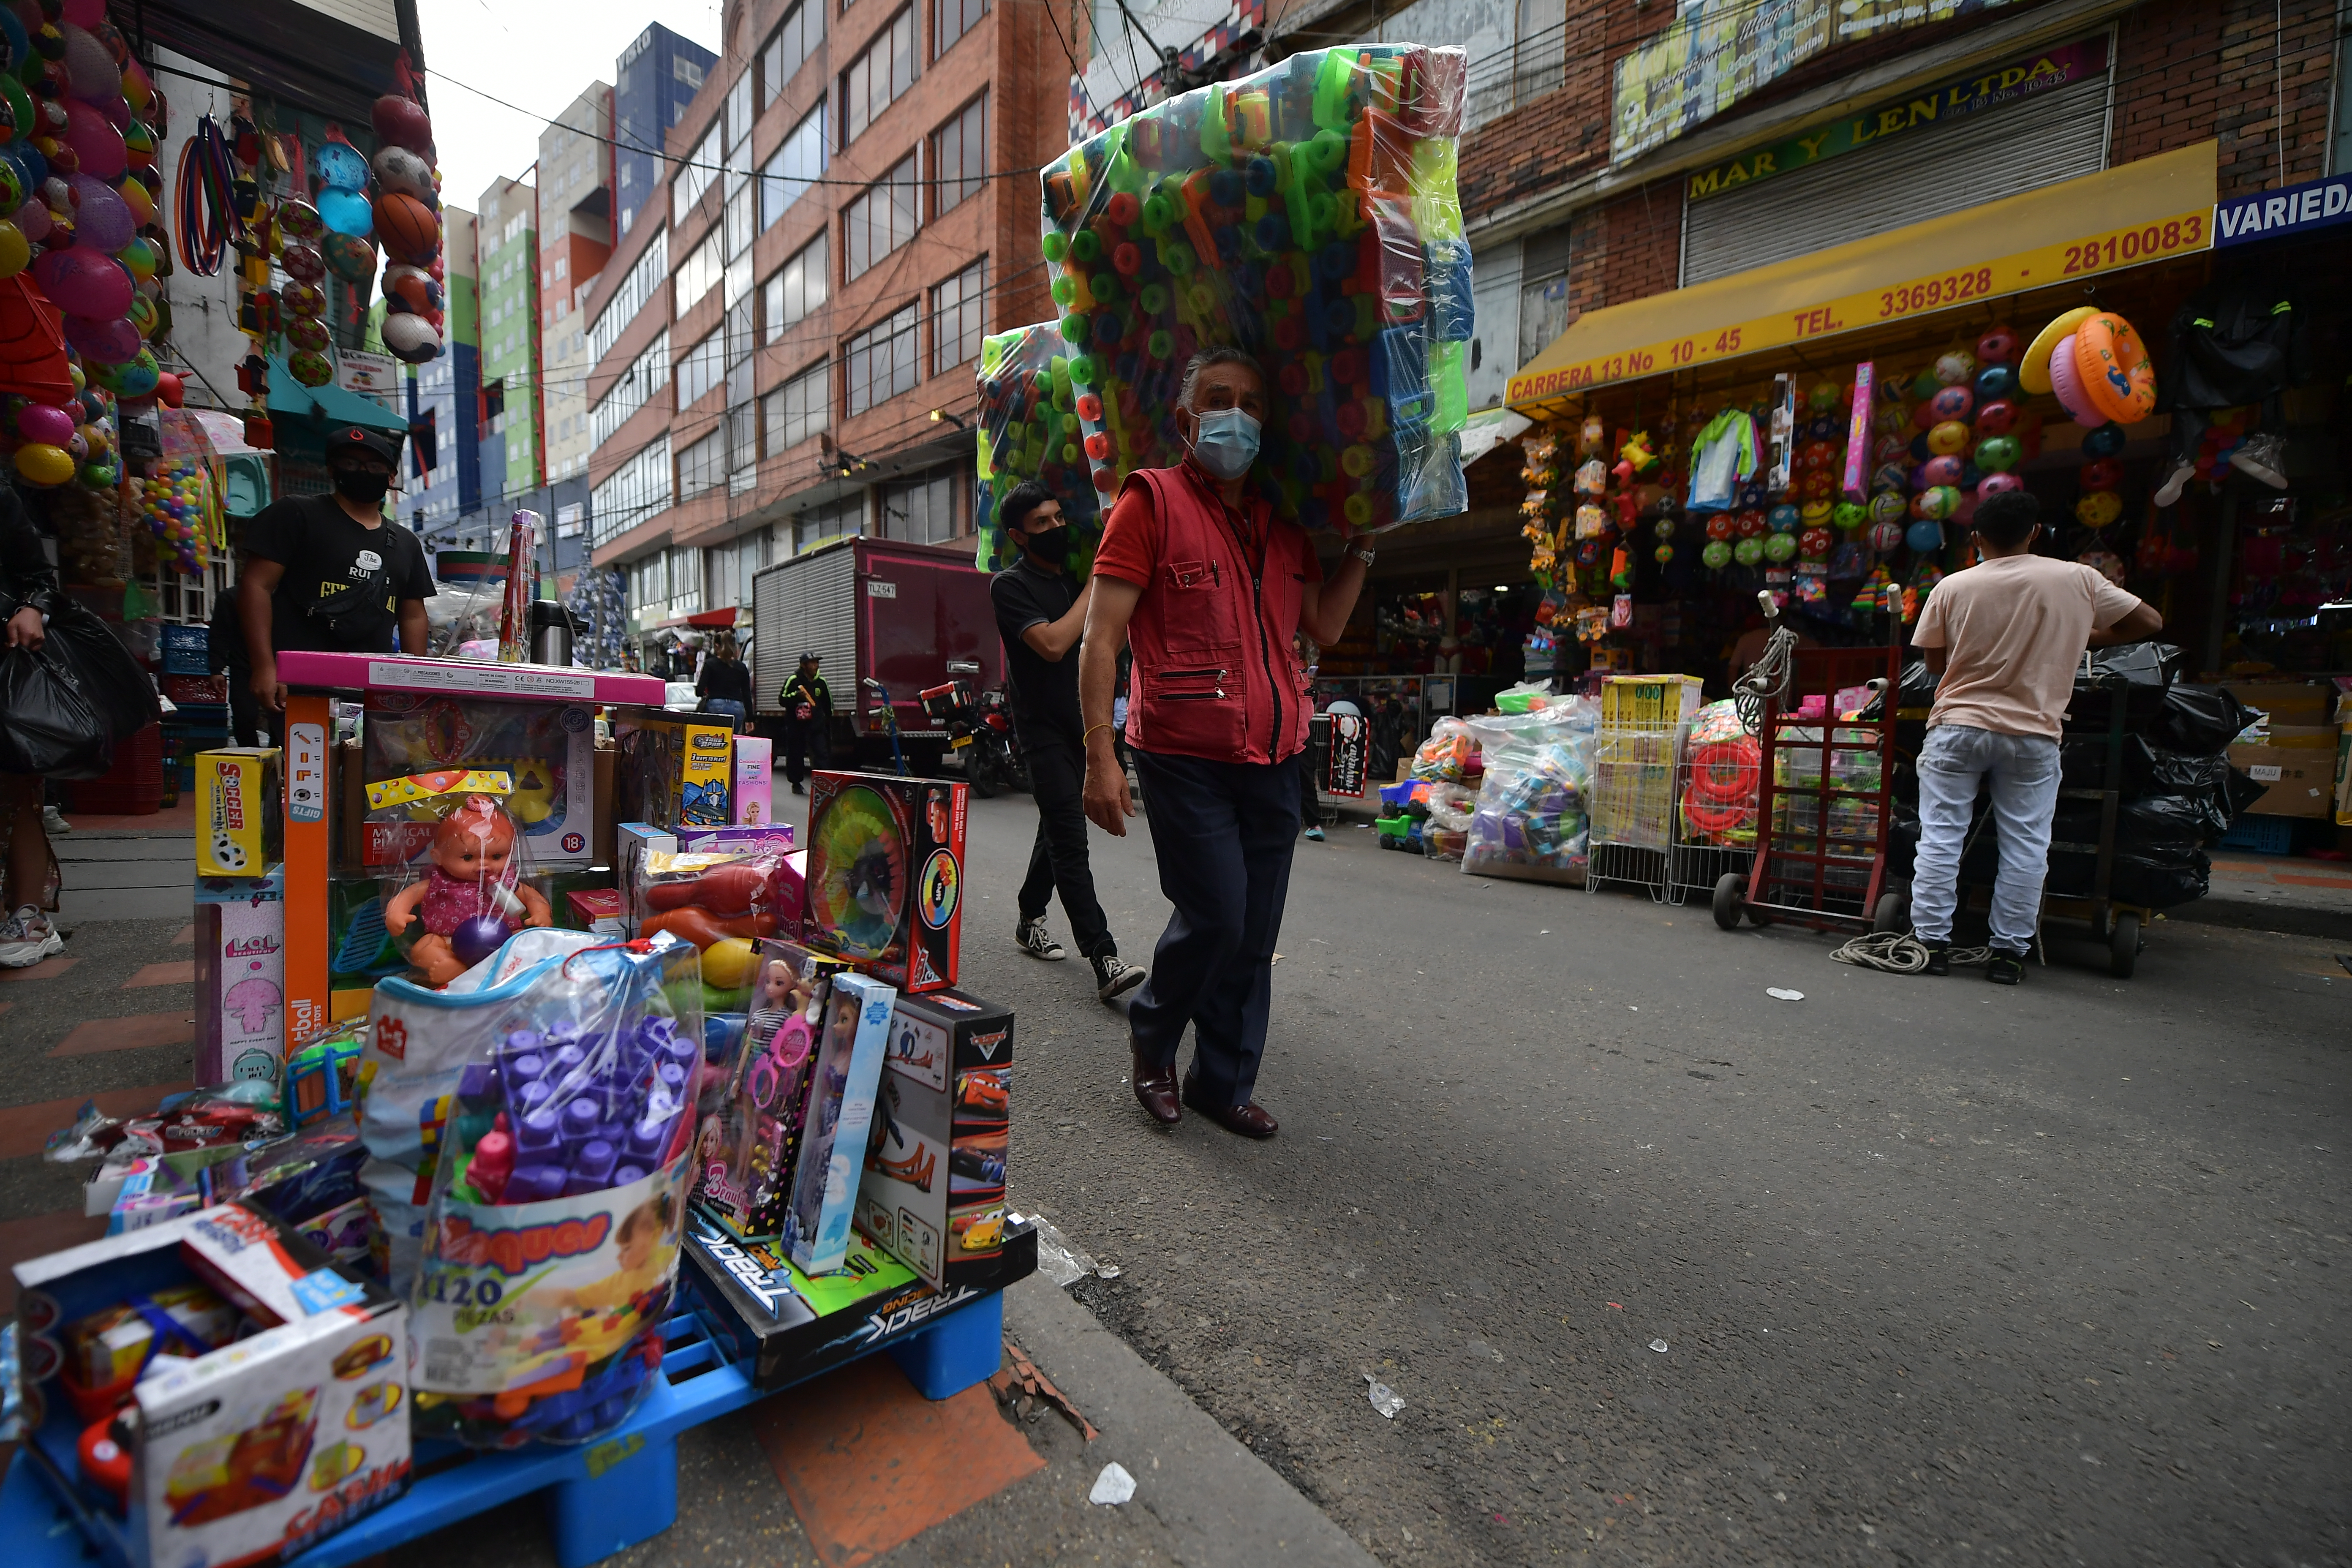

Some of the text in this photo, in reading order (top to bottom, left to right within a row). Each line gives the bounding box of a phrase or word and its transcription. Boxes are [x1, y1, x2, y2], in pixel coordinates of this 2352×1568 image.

[1689, 58, 2072, 199] MAR Y LEN LTDA.
[1511, 365, 1593, 400] CARRERA
[1602, 359, 1622, 380] 13
[1628, 351, 1653, 373] No
[1670, 340, 1693, 364] 10
[1715, 328, 1742, 353] 45
[1794, 308, 1843, 336] TEL.
[1878, 268, 1992, 317] 3369328
[2063, 215, 2202, 273] 2810083
[364, 553, 377, 563] The
[2255, 768, 2276, 776] MAJU
[292, 806, 321, 819] GIFTS
[566, 837, 579, 849] 18
[233, 949, 271, 957] BEAUTIFUL
[704, 1163, 745, 1212] Beauty
[697, 1233, 791, 1311] TRACK
[865, 1284, 979, 1343] TRACK
